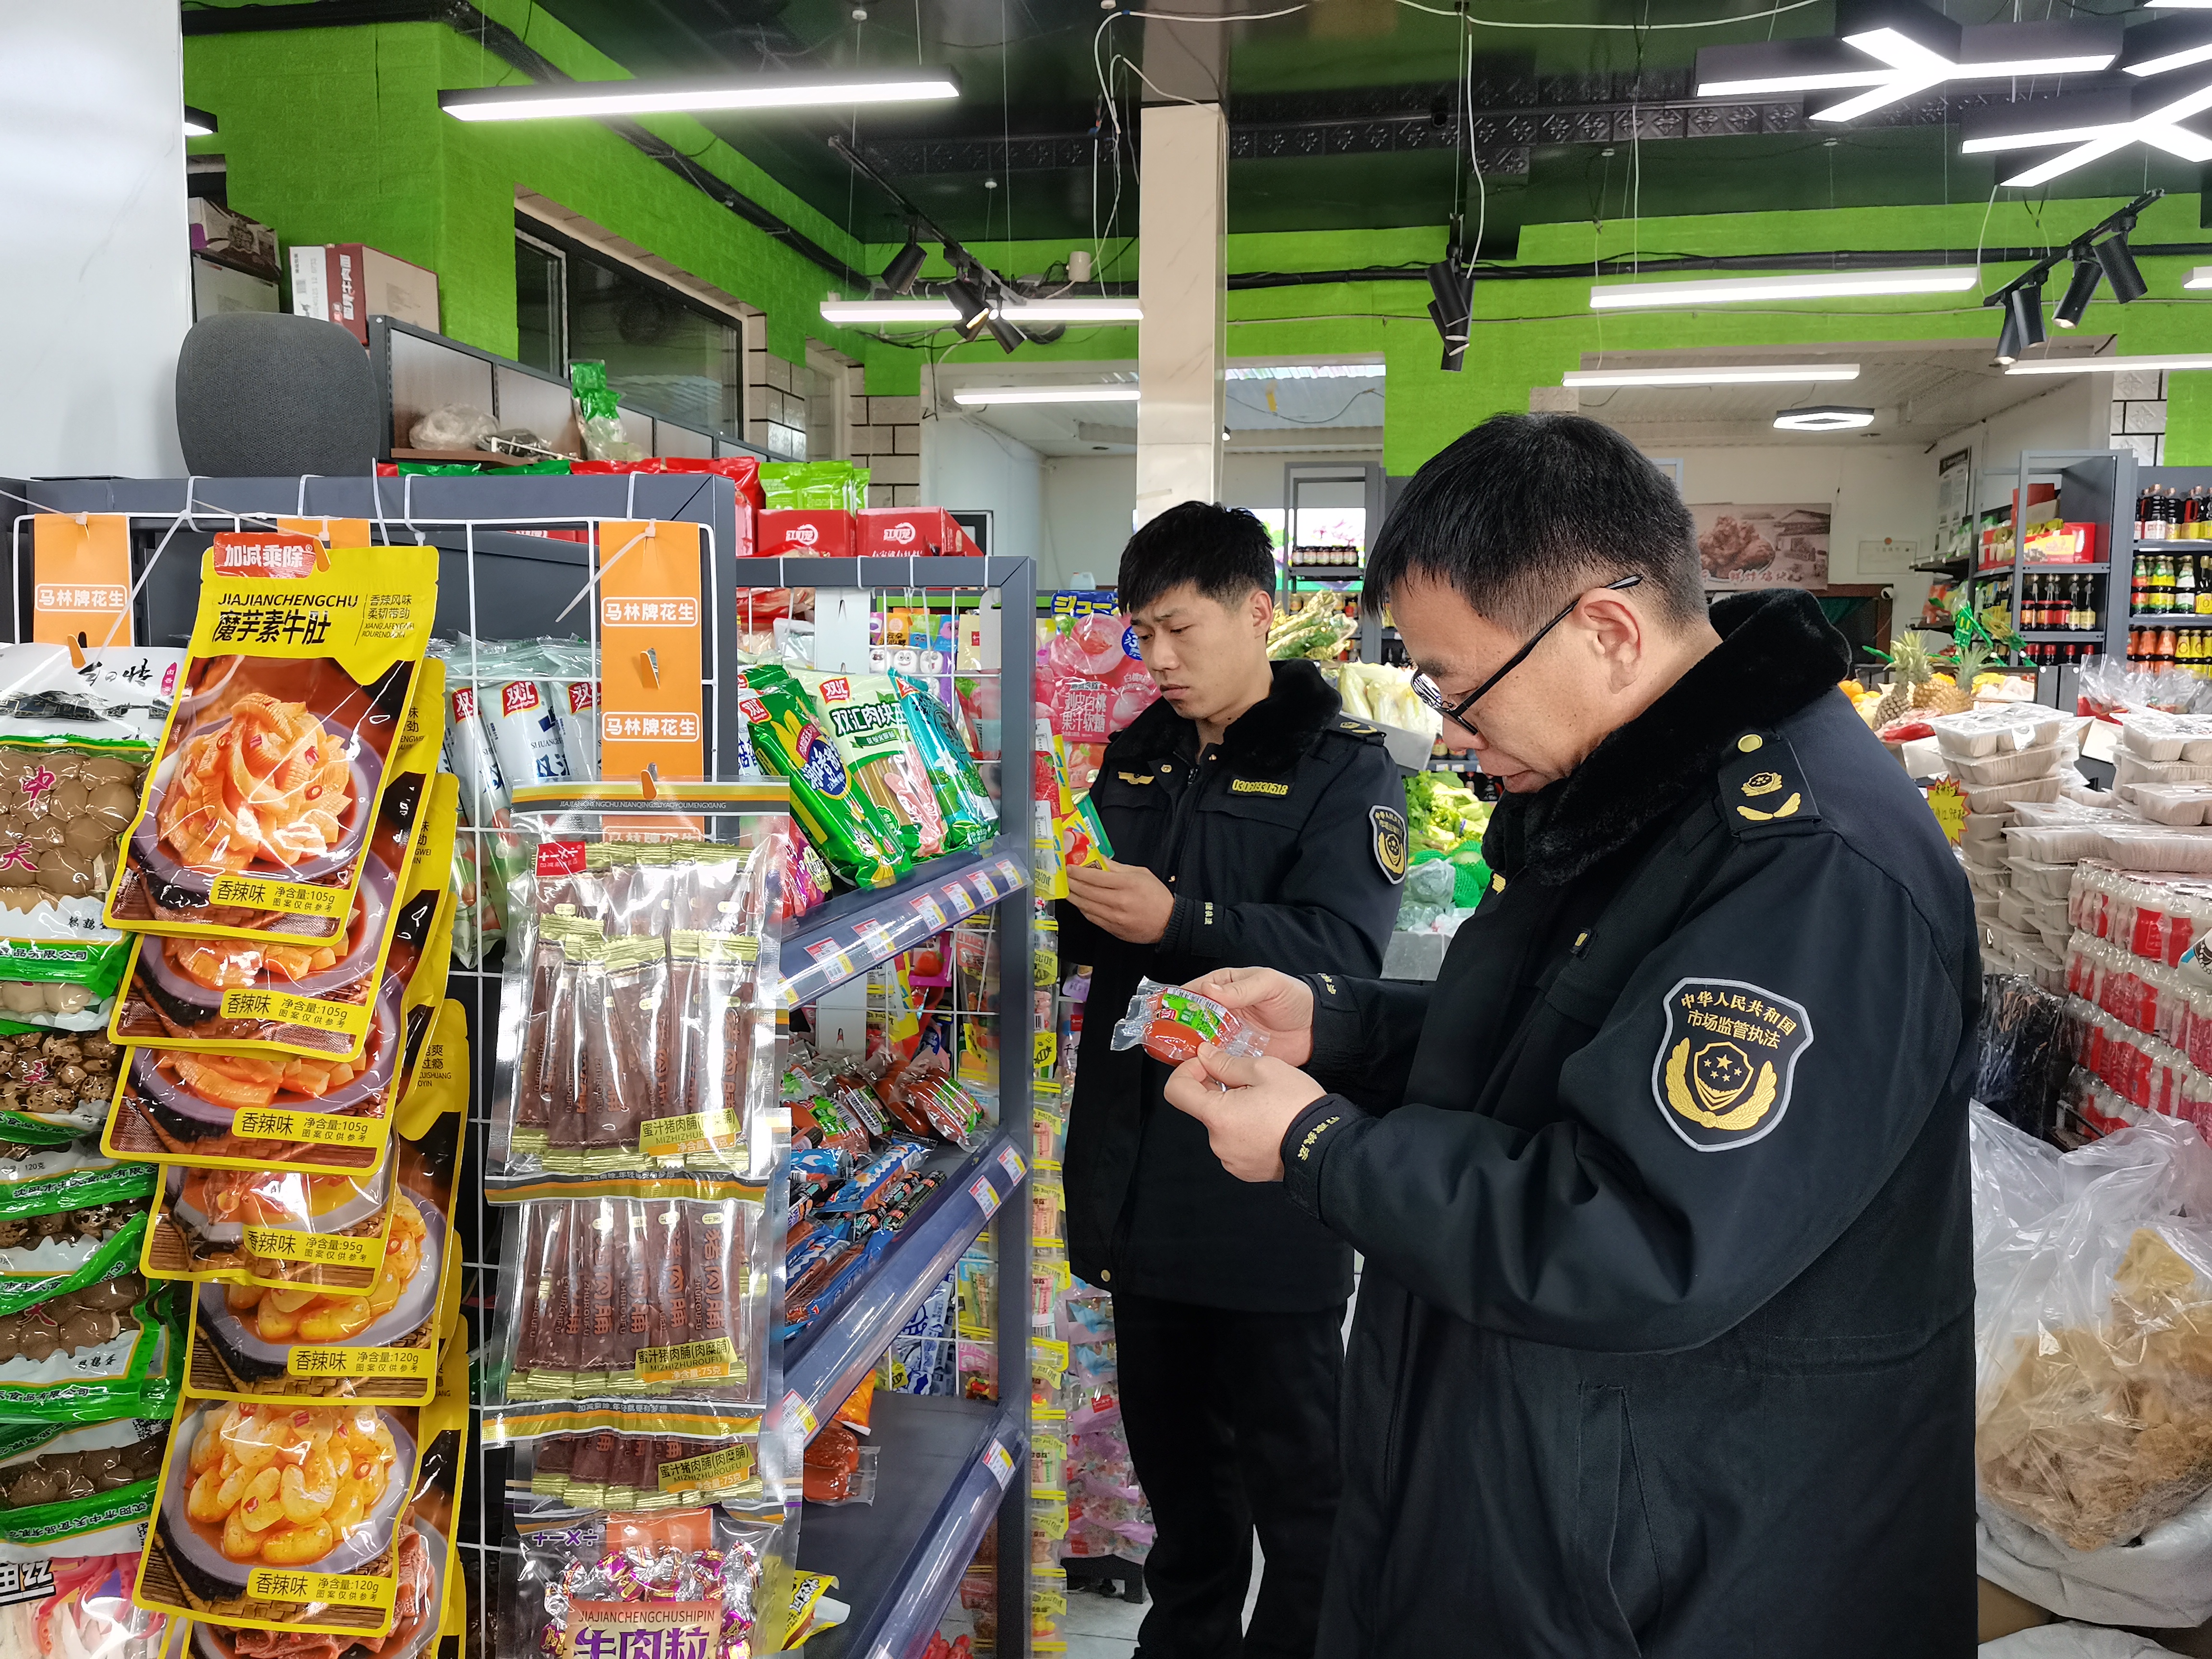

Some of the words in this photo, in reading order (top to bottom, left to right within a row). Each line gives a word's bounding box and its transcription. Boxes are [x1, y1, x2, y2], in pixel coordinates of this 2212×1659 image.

[225, 544, 303, 567] 加减乘除
[39, 589, 124, 607] 马林牌花生
[218, 594, 358, 607] JIAJIANCHENGCHU
[370, 594, 412, 605] 香辣风味
[605, 603, 696, 621] 马林牌花生
[212, 609, 331, 645] 魔芋素牛肚
[605, 718, 696, 737] 马林牌花生
[217, 880, 266, 904] 香辣味
[275, 886, 335, 904] 净含量:105g
[273, 898, 332, 912] 图案仅供参考
[227, 993, 271, 1015] 香辣味
[281, 998, 348, 1020] 净含量:105g
[278, 1010, 346, 1028] 图案仅供参考
[1681, 991, 1797, 1036] 中华人民共和国
[1687, 1010, 1780, 1049] 市场监管执法
[242, 1112, 294, 1135] 香辣味
[304, 1117, 368, 1133] 净含量:105g
[301, 1129, 366, 1142] 图案仅供参考
[677, 1137, 728, 1152] 净含量:5克
[248, 1230, 296, 1255] 香辣味
[306, 1237, 363, 1253] 净含量:95g
[304, 1249, 367, 1262] 图案仅供参考
[296, 1350, 347, 1372] 香辣味
[357, 1352, 419, 1364] 净含量:120g
[355, 1363, 418, 1372] 图案仅供参考
[256, 1573, 308, 1597] 香辣味
[318, 1577, 379, 1593] 净含量:120g
[316, 1589, 377, 1602] 图案仅供参考
[578, 1610, 714, 1623] JIAJIANCHENGCHUSHIPIN
[574, 1627, 709, 1659] 牛肉粒
